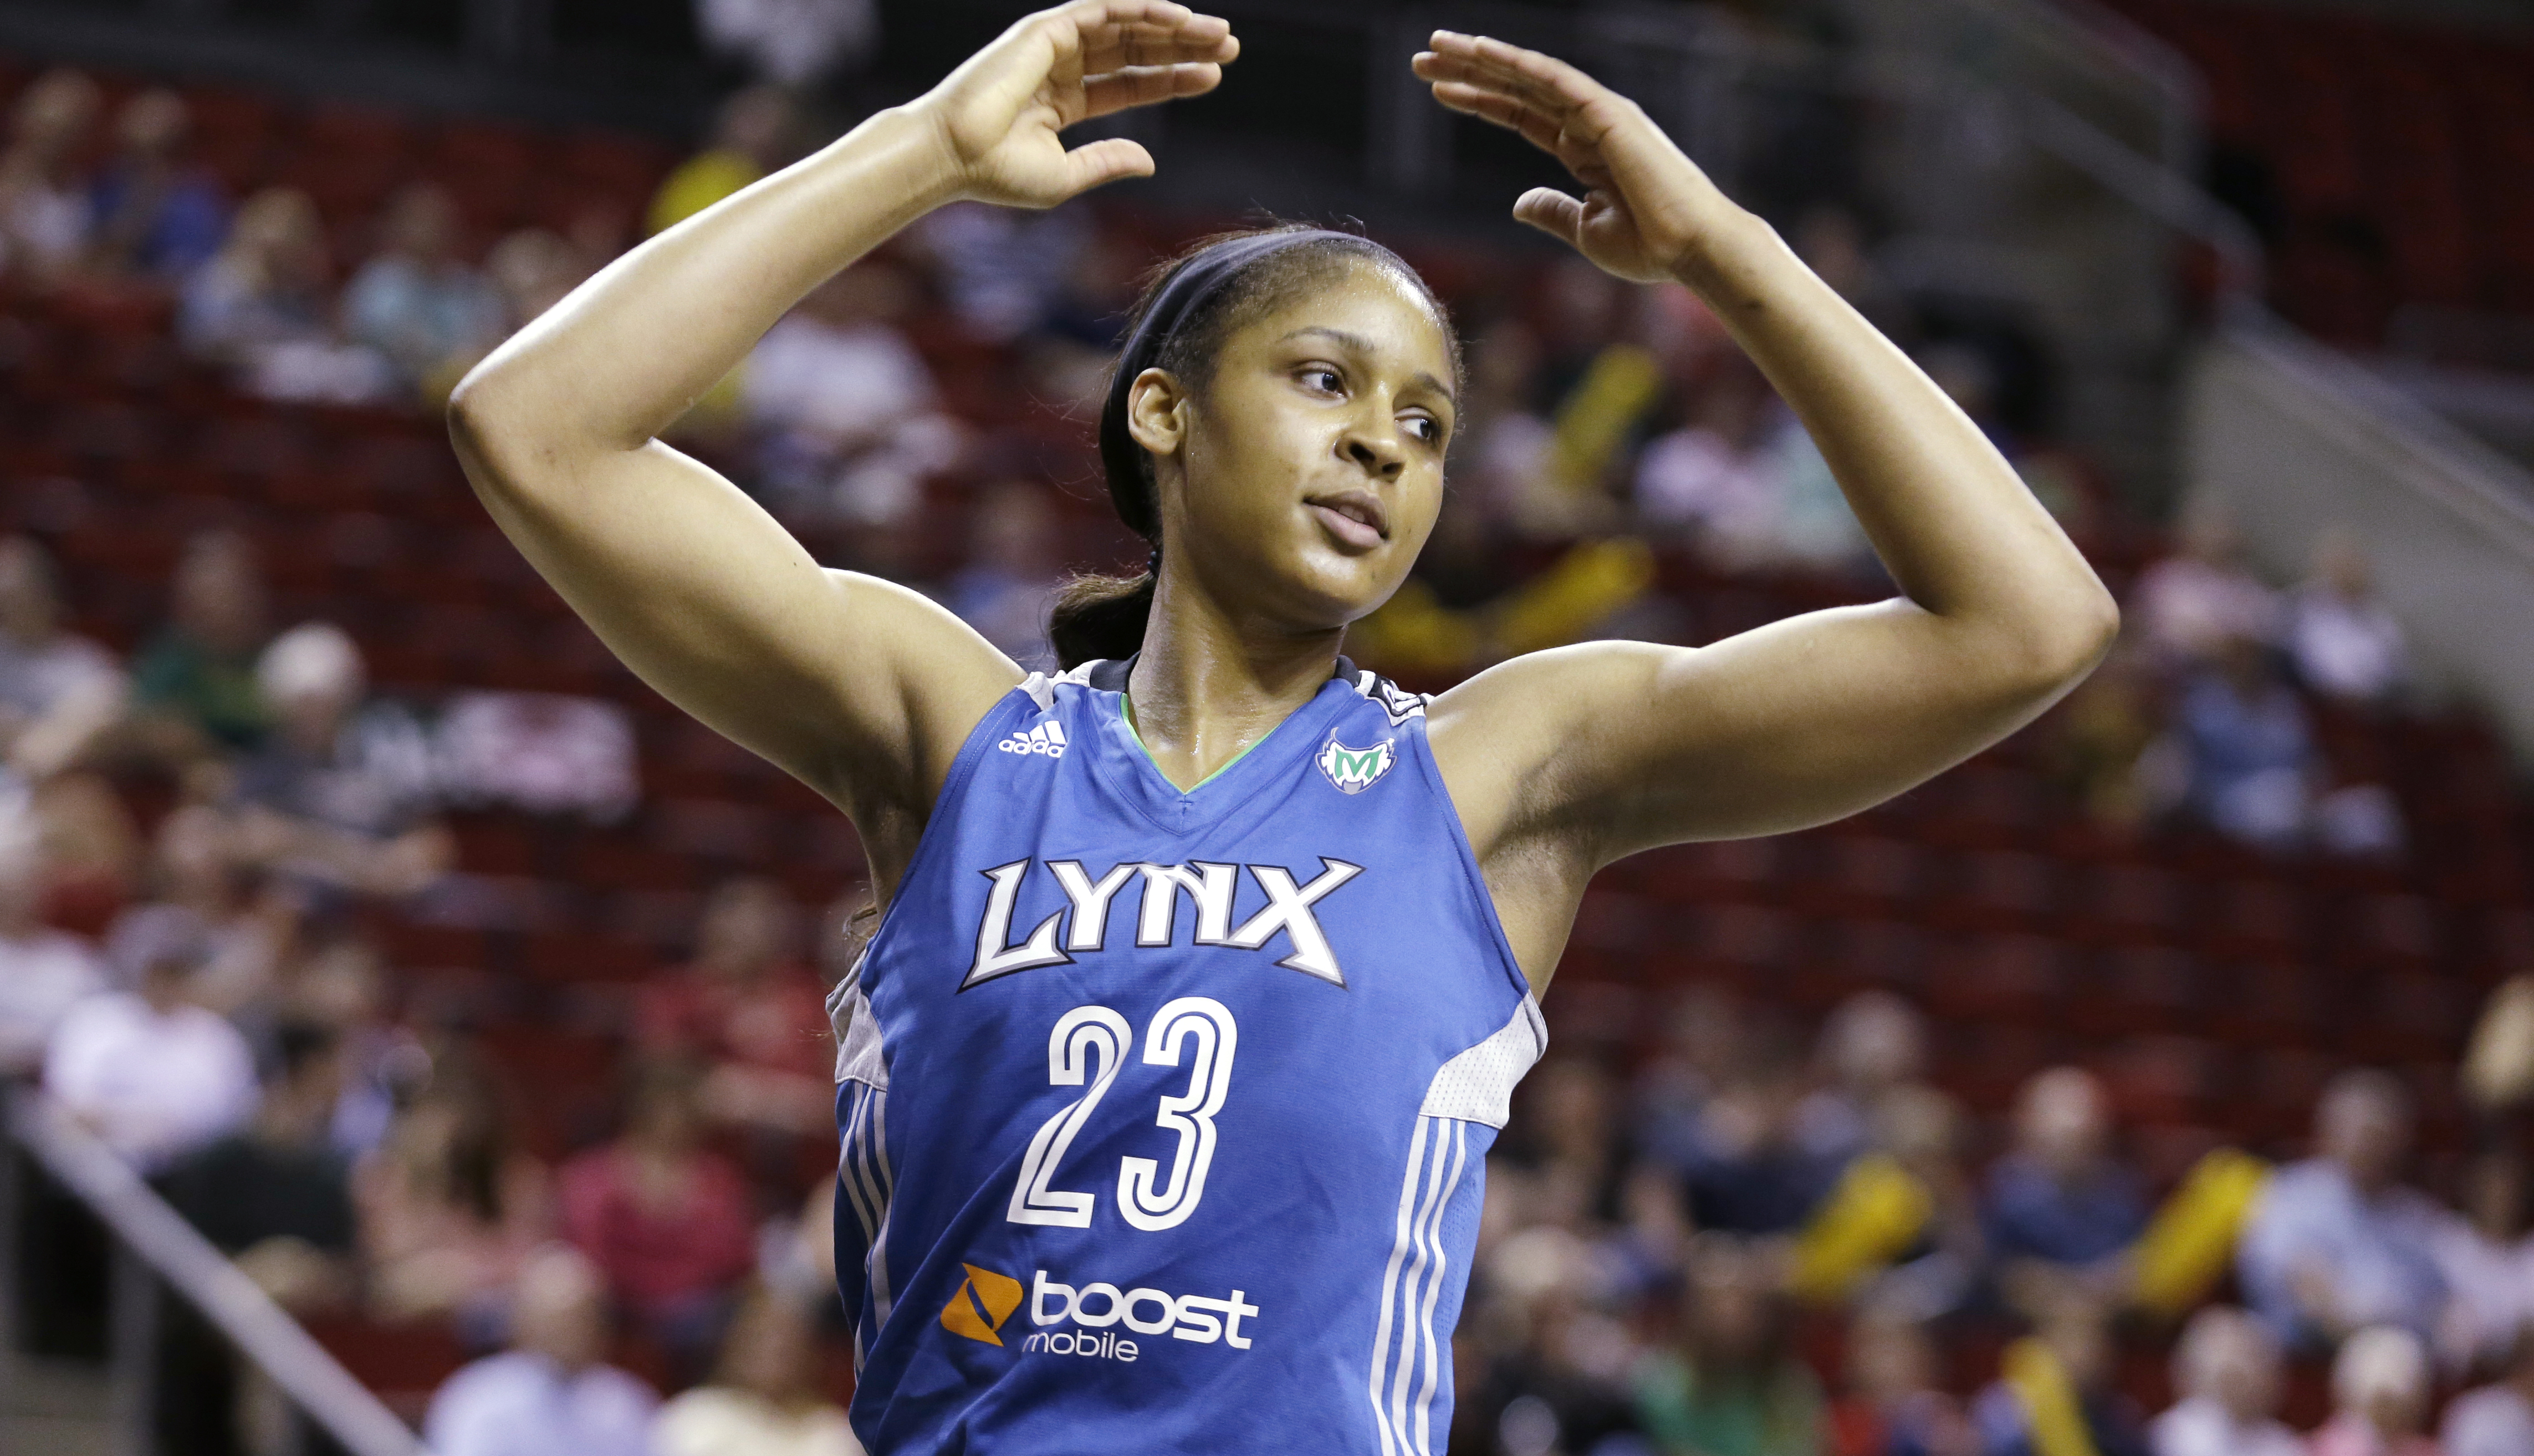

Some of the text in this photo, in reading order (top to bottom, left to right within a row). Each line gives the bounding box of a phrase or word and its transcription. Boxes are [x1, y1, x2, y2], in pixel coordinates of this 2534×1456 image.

[998, 737, 1065, 758] adida
[1335, 747, 1383, 779] M
[956, 856, 1366, 994] LYNX
[1007, 997, 1238, 1231] 23
[1031, 1270, 1259, 1349] boost
[1022, 1329, 1139, 1362] mobile
